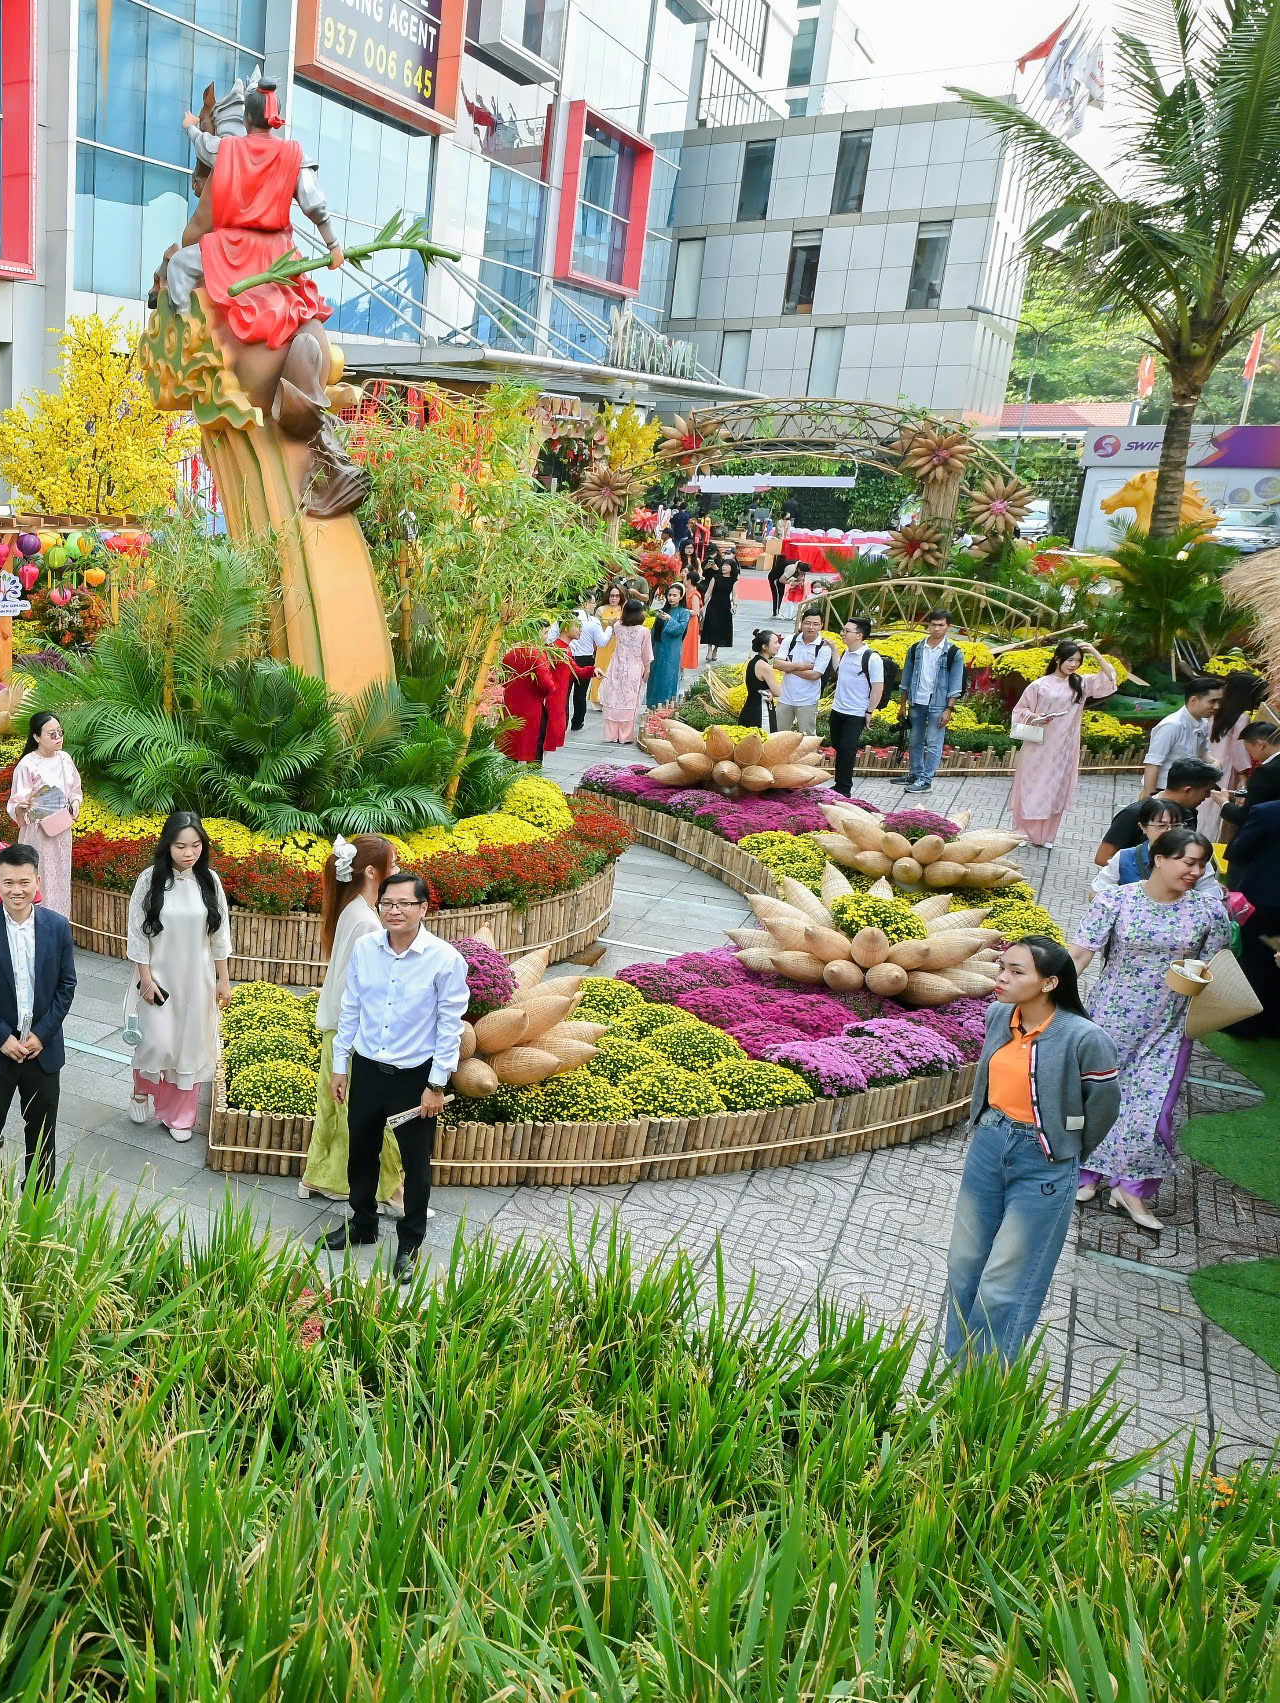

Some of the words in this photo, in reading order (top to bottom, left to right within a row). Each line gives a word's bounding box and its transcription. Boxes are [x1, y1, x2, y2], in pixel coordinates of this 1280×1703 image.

[388, 3, 437, 53] AGENT
[323, 16, 358, 59] 937
[364, 37, 398, 80] 006
[403, 58, 433, 99] 645
[1124, 441, 1163, 451] SWIF
